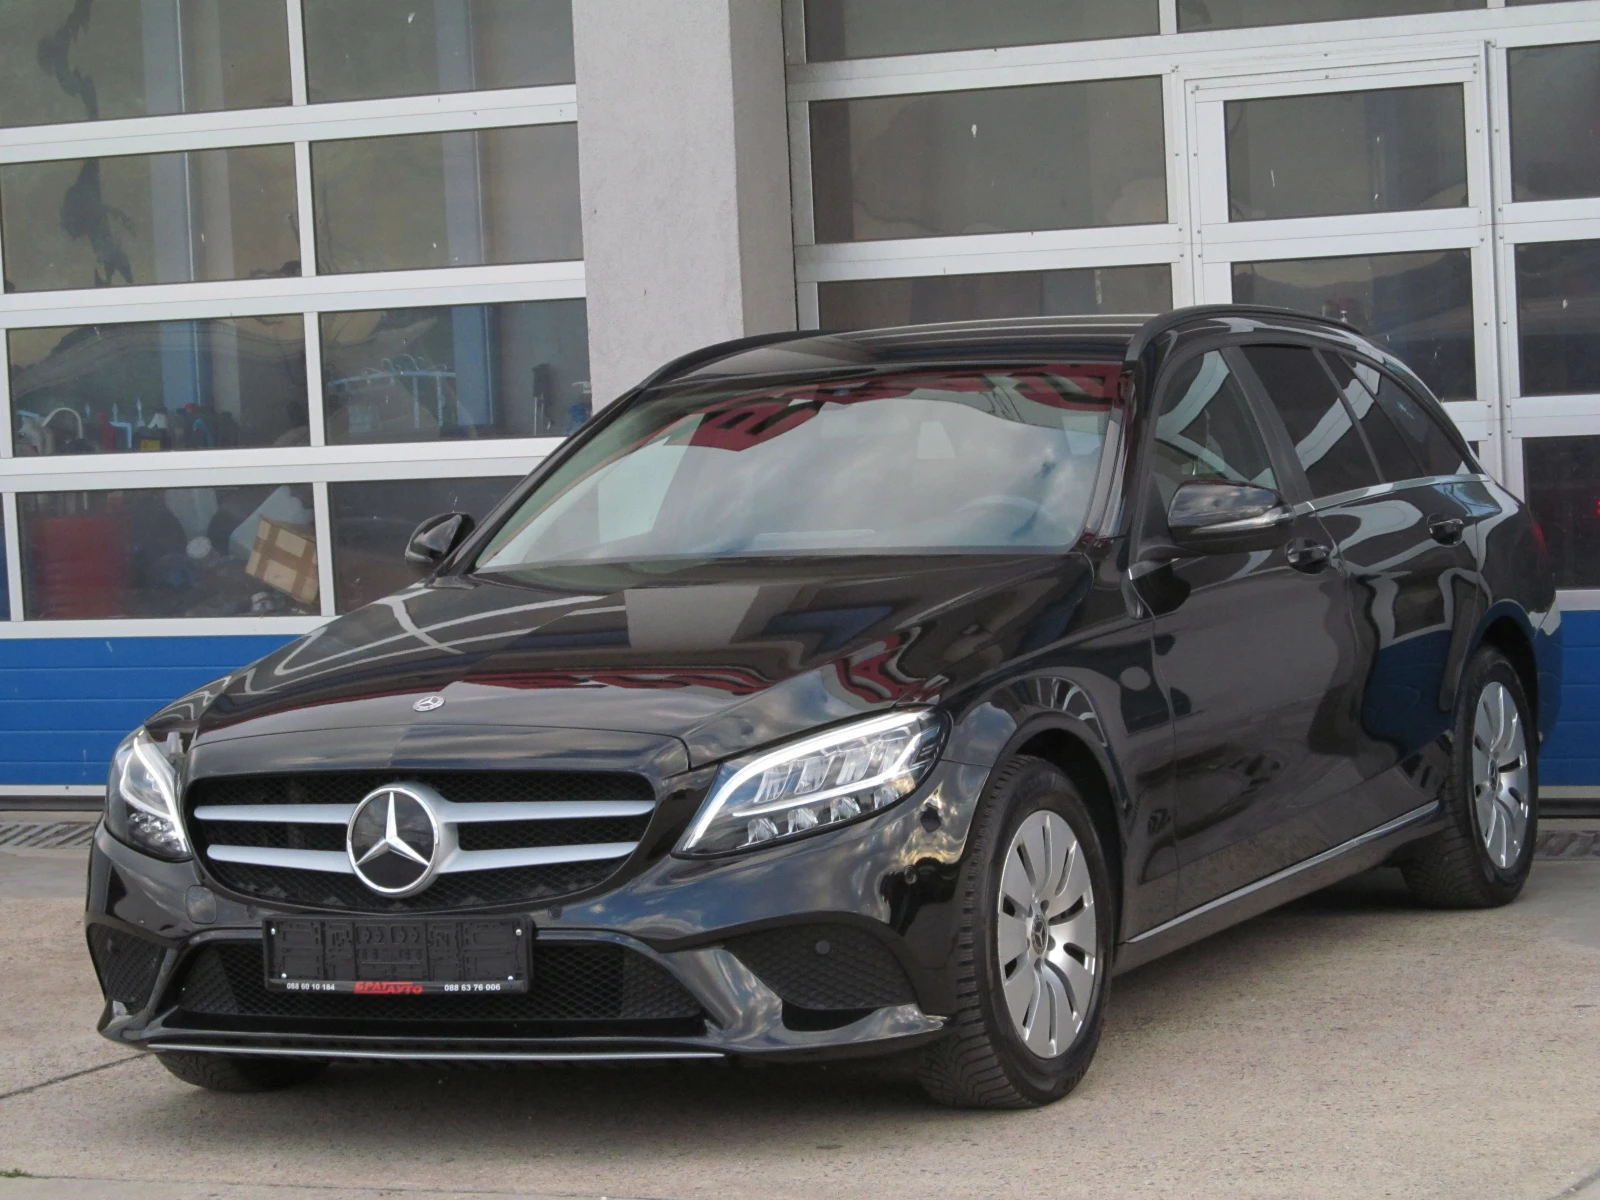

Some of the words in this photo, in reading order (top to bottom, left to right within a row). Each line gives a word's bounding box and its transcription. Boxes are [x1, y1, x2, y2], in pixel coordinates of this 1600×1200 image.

[286, 982, 299, 990] 088
[301, 982, 309, 990] 60
[322, 983, 335, 991] 184
[473, 983, 483, 991] 76
[485, 983, 501, 991] 006
